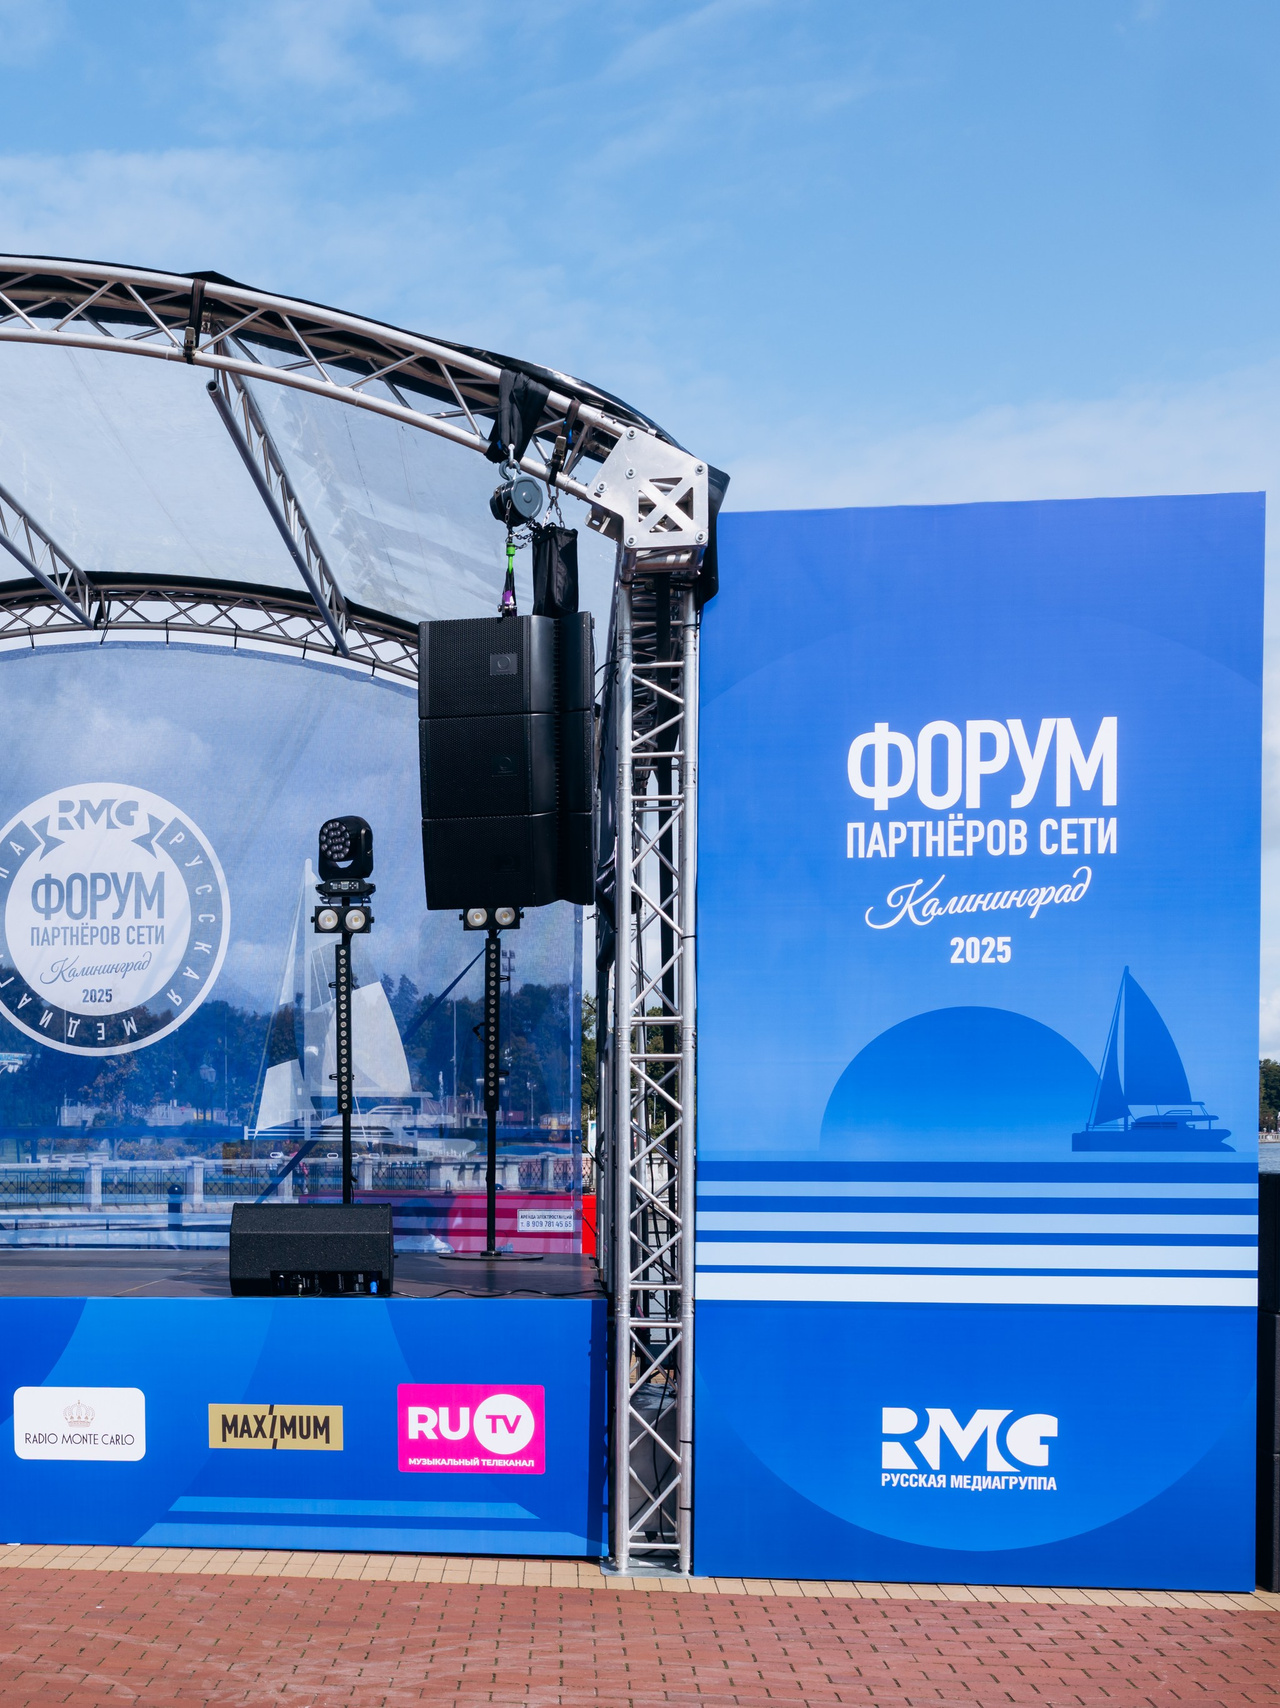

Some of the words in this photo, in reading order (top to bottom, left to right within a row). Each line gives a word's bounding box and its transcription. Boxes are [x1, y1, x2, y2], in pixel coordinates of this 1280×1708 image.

[847, 716, 1118, 811] ФОРУМ
[57, 798, 139, 831] RMG
[846, 813, 1028, 859] ПАРТНЁРОВ
[1039, 817, 1118, 856] СЕТИ
[30, 871, 165, 921] ФОРУМ
[864, 866, 1093, 930] Калининград
[30, 922, 121, 947] ПАРТНЁРОВ
[126, 924, 165, 946] СЕТИ
[166, 831, 216, 1007] РУССКАЯ
[39, 950, 153, 985] Калининград
[950, 936, 1012, 964] 2025
[82, 988, 113, 1003] 2025
[25, 1432, 58, 1445] RADIO
[61, 1433, 99, 1446] MONTE
[101, 1433, 135, 1447] CARLO
[408, 1406, 470, 1441] RU
[485, 1414, 522, 1434] TV
[881, 1407, 1058, 1473] RMG
[408, 1457, 480, 1466] МУЗЫКАЛЬНЫЙ
[481, 1458, 535, 1467] ТЕЛЕКАНАЛ
[881, 1472, 946, 1488] РУССКАЯ
[950, 1474, 1058, 1492] МЕДИАГРУППА
